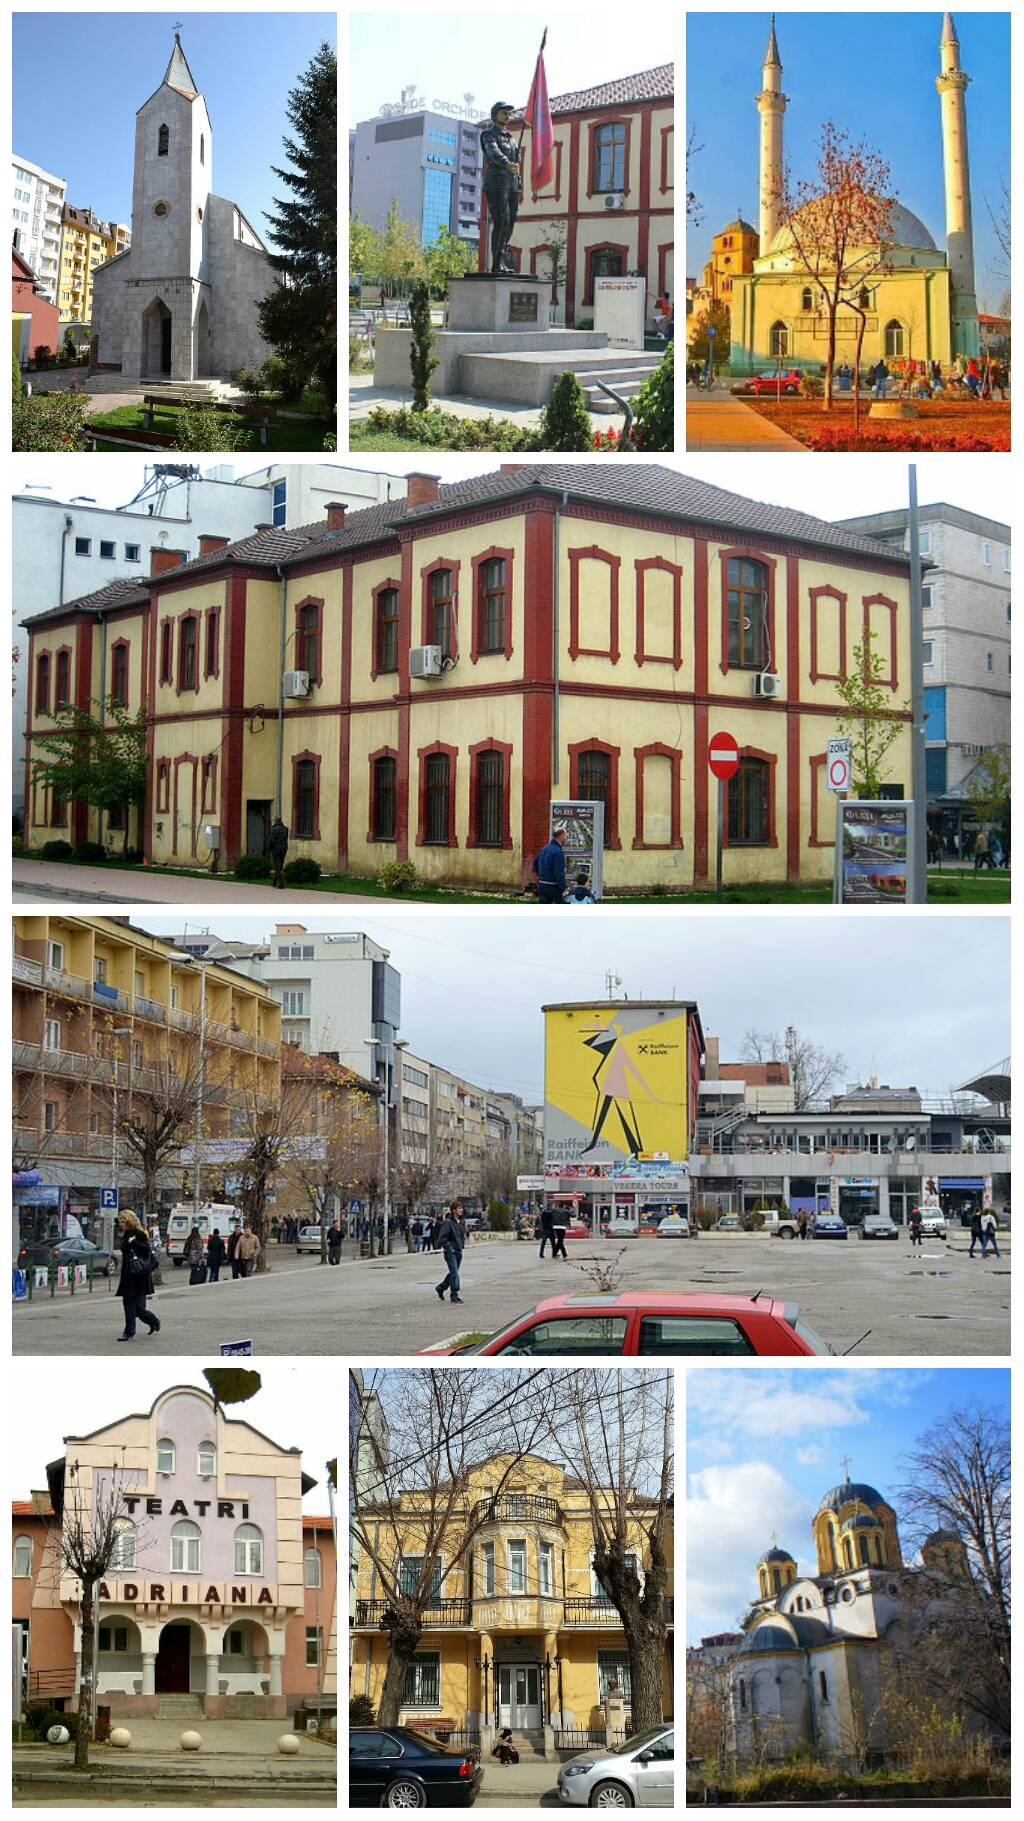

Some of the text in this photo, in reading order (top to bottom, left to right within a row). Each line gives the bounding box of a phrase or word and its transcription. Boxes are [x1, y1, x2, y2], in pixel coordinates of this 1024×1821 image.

[547, 1138, 609, 1149] Raiffeien
[547, 1151, 584, 1160] BANK
[649, 1182, 679, 1190] TOURS
[104, 1190, 114, 1205] P
[123, 1497, 249, 1519] TEATRI
[99, 1583, 273, 1603] ADRIANA
